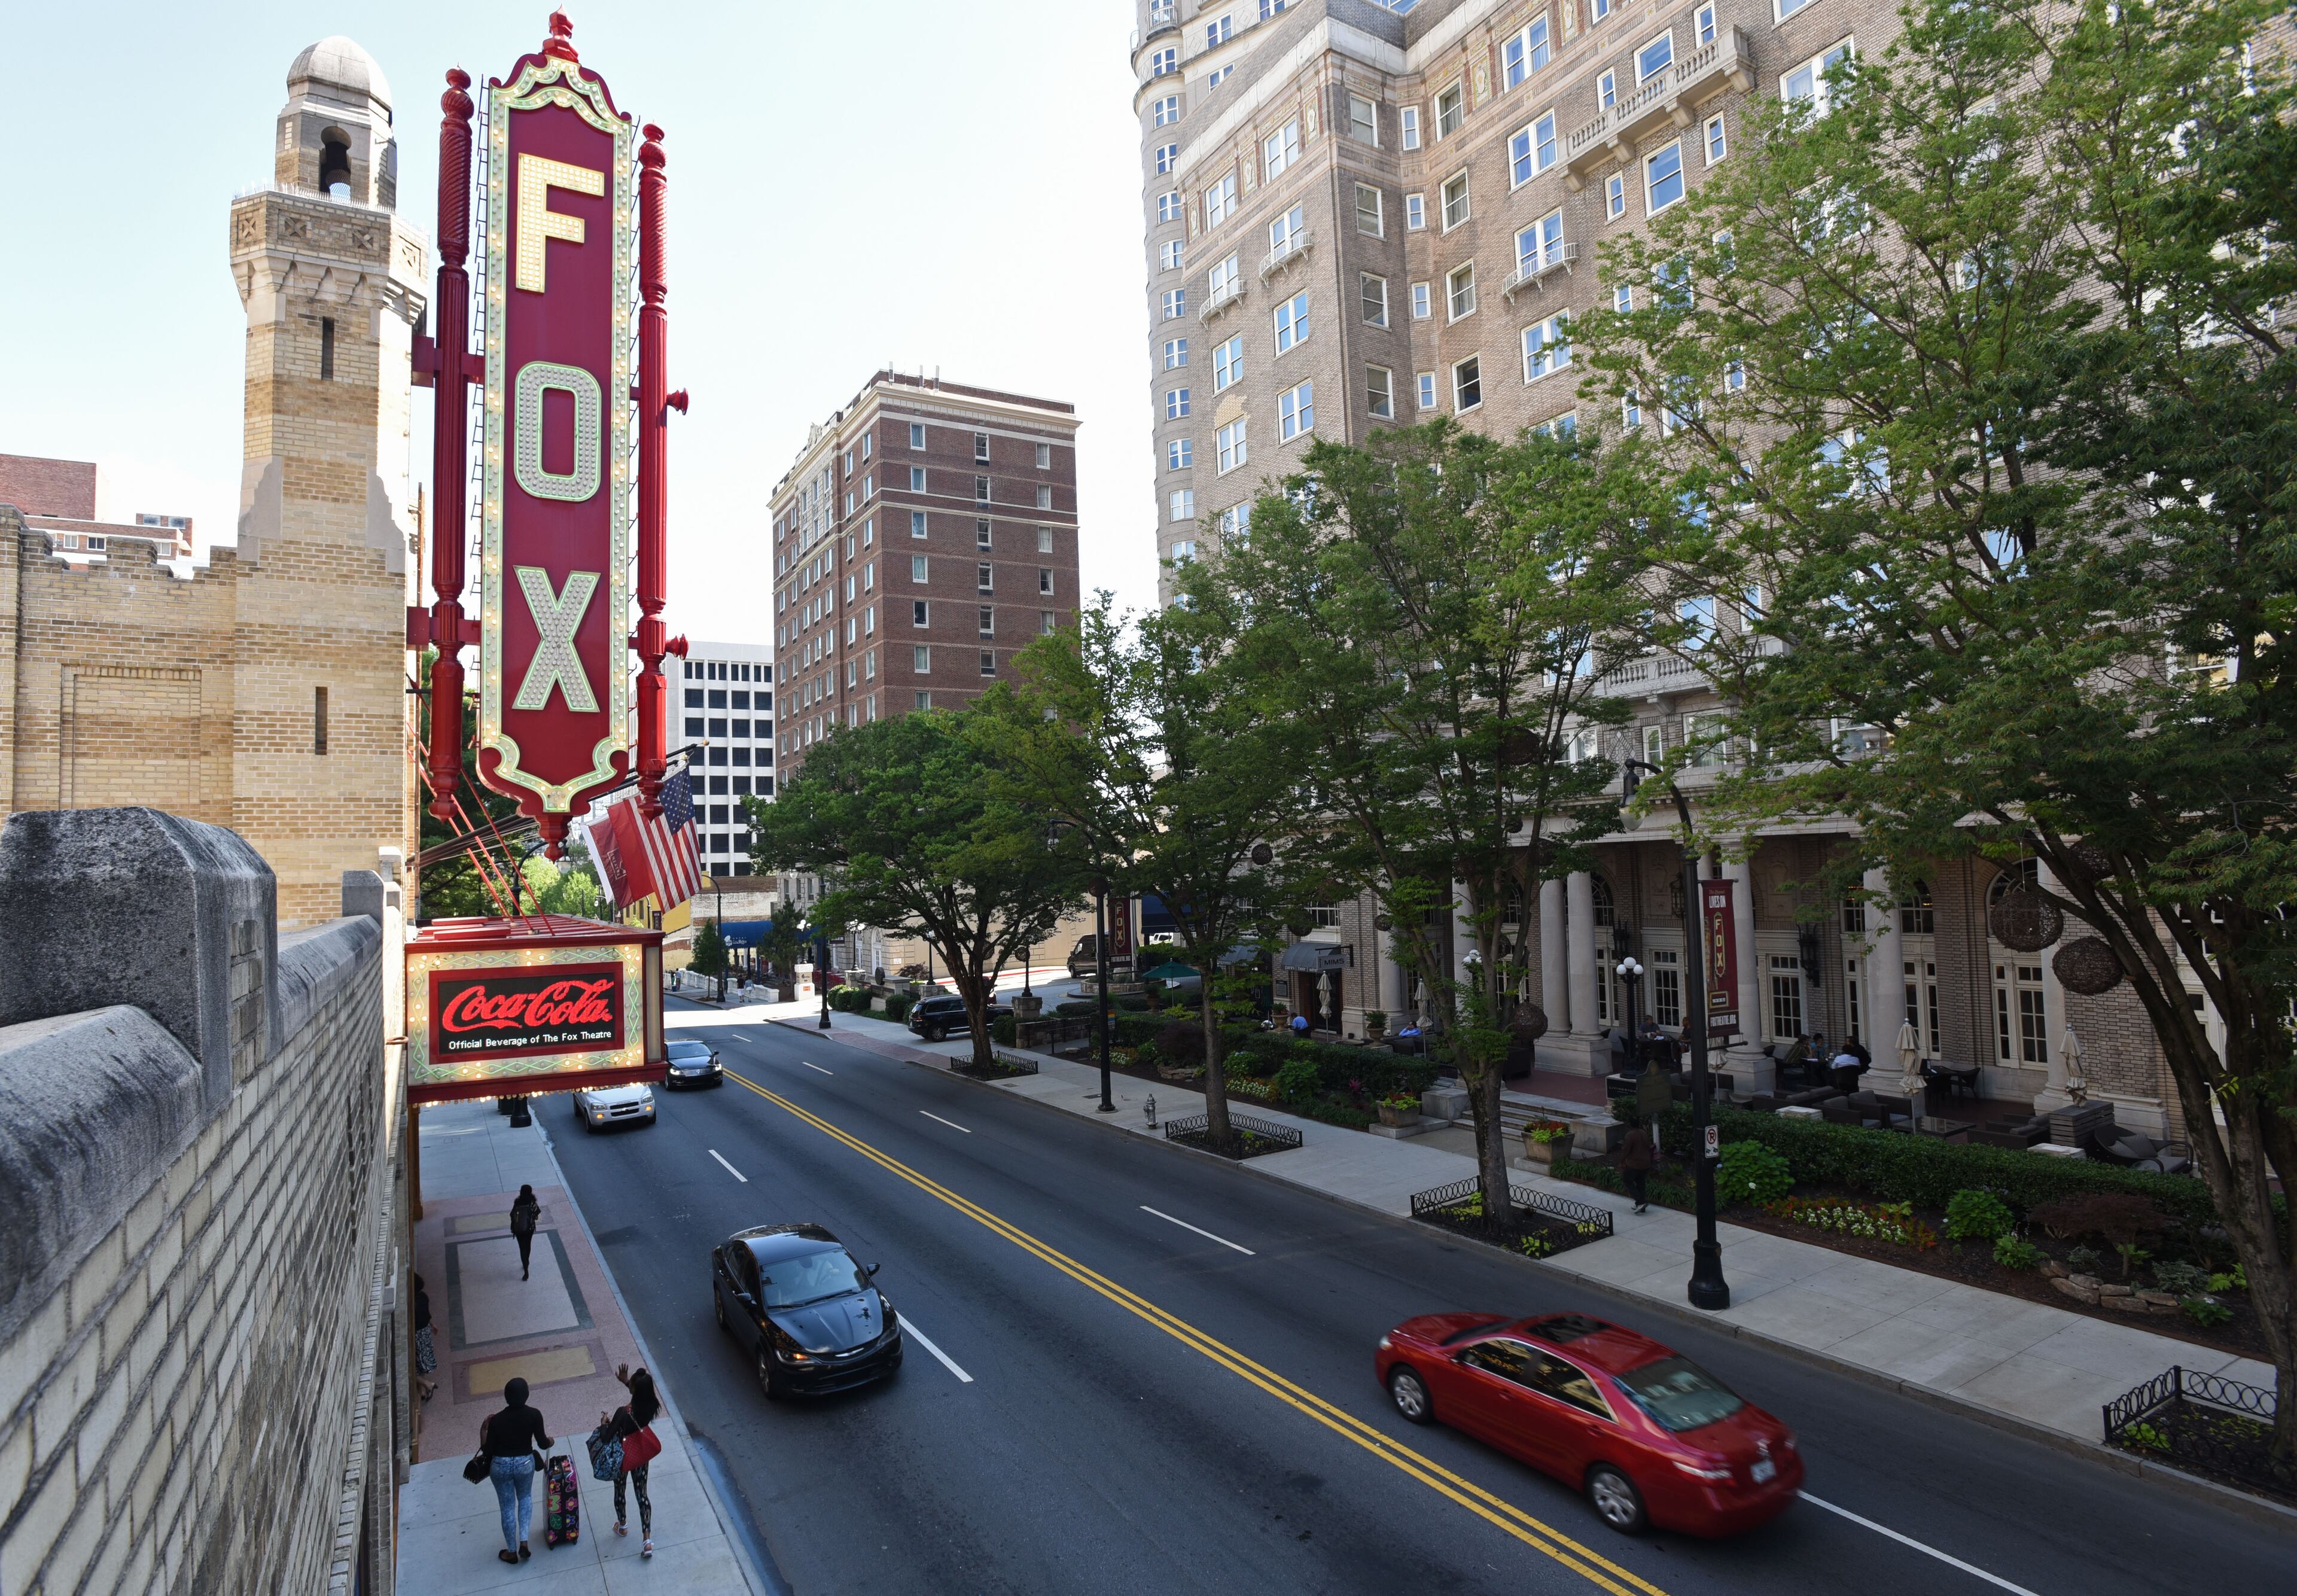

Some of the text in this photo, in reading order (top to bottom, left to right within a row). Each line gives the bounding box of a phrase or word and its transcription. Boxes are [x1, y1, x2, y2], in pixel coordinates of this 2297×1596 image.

[512, 153, 605, 712] FOX
[442, 979, 614, 1032] Coca-Cola
[449, 1031, 611, 1050] Official Beverage of The Fox Theatre
